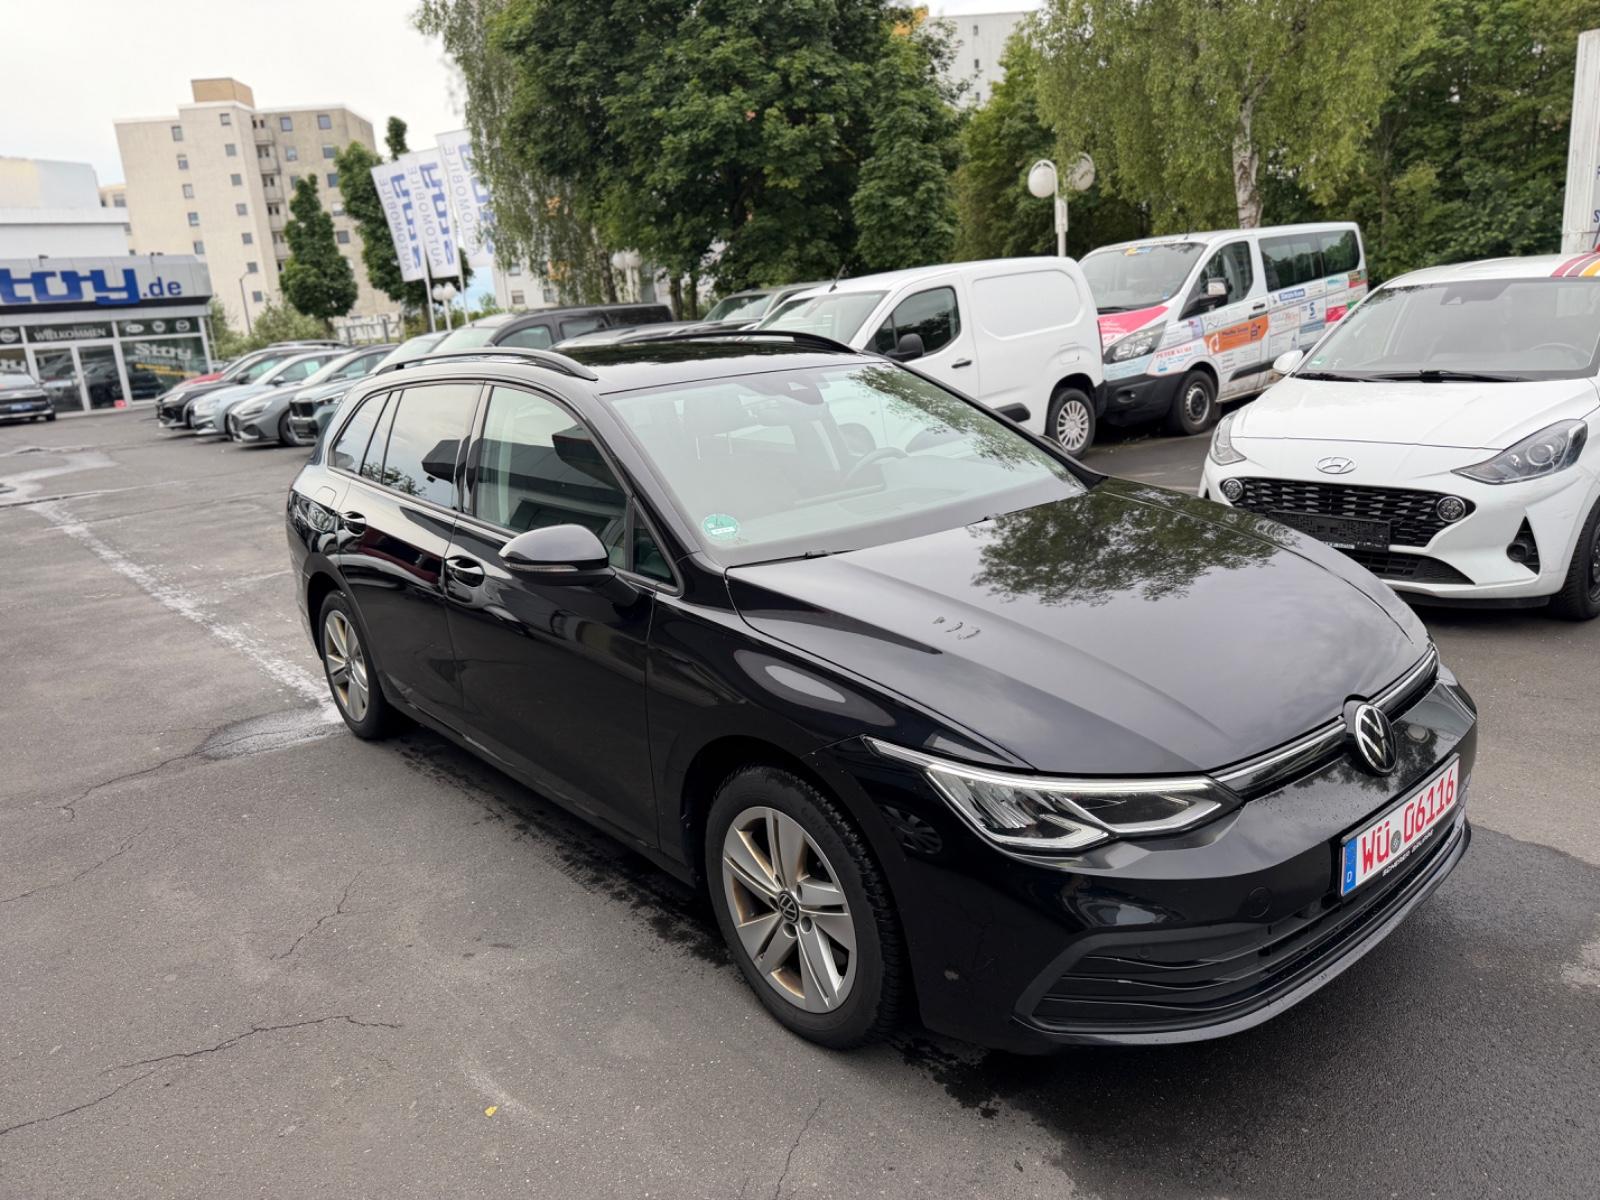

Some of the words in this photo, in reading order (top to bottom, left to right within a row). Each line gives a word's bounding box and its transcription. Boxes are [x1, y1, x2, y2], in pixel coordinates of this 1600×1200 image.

[1362, 820, 1390, 874] WÜ
[1404, 769, 1454, 843] 06116
[1346, 870, 1353, 883] D
